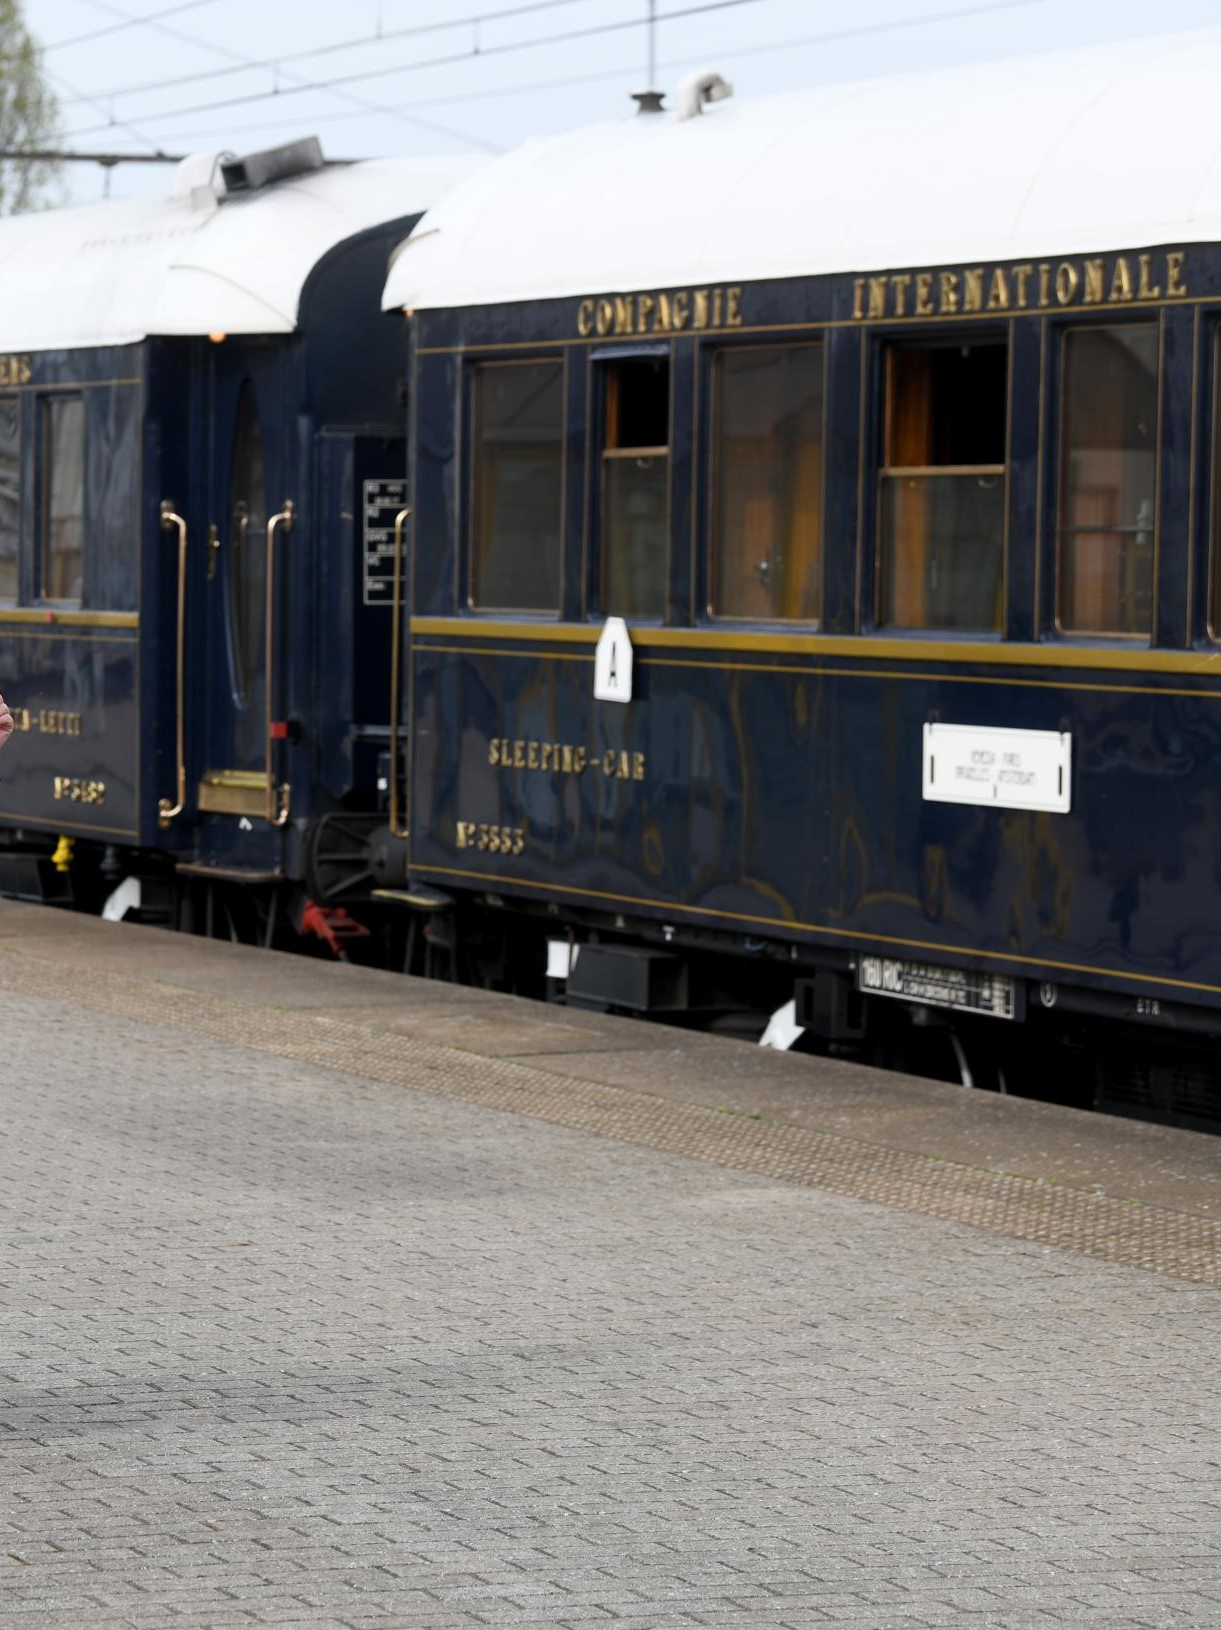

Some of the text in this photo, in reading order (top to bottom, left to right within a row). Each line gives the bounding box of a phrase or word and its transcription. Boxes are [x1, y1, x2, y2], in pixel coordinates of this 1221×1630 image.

[577, 251, 1188, 337] COMPAGNIE INTERNATIONALE
[487, 737, 646, 781] SLEEPING-CAR
